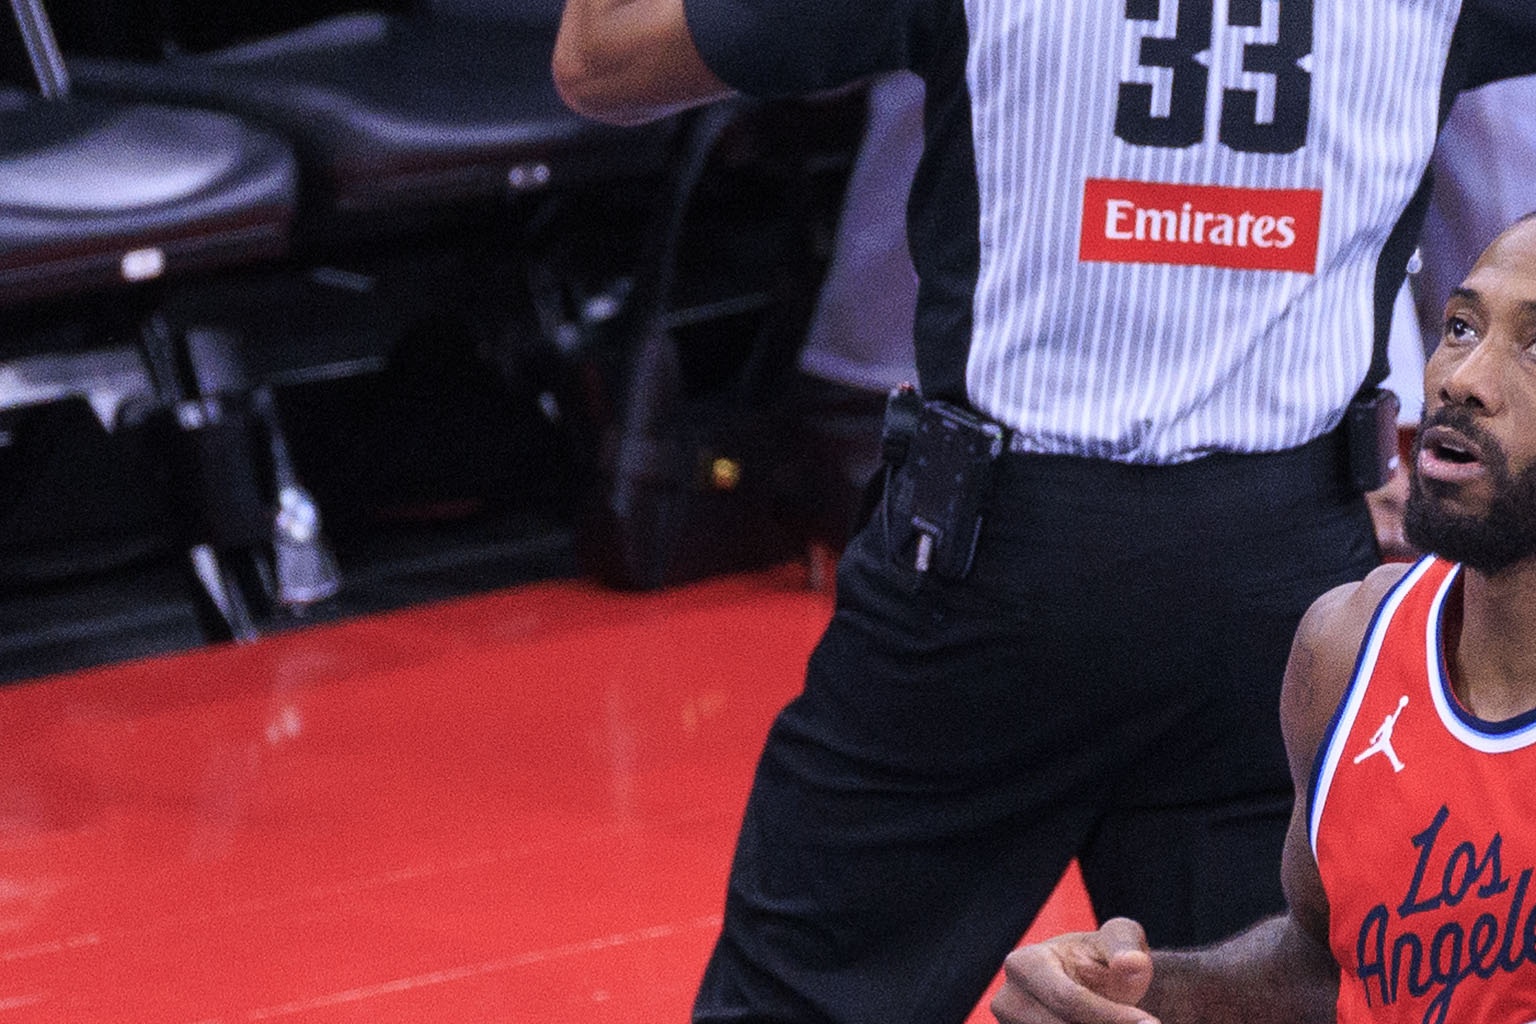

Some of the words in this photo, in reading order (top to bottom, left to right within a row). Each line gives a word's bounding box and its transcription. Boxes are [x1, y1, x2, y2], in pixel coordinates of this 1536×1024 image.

[1114, 0, 1314, 154] 33
[1105, 198, 1296, 249] Emirates
[1397, 804, 1510, 919] Los
